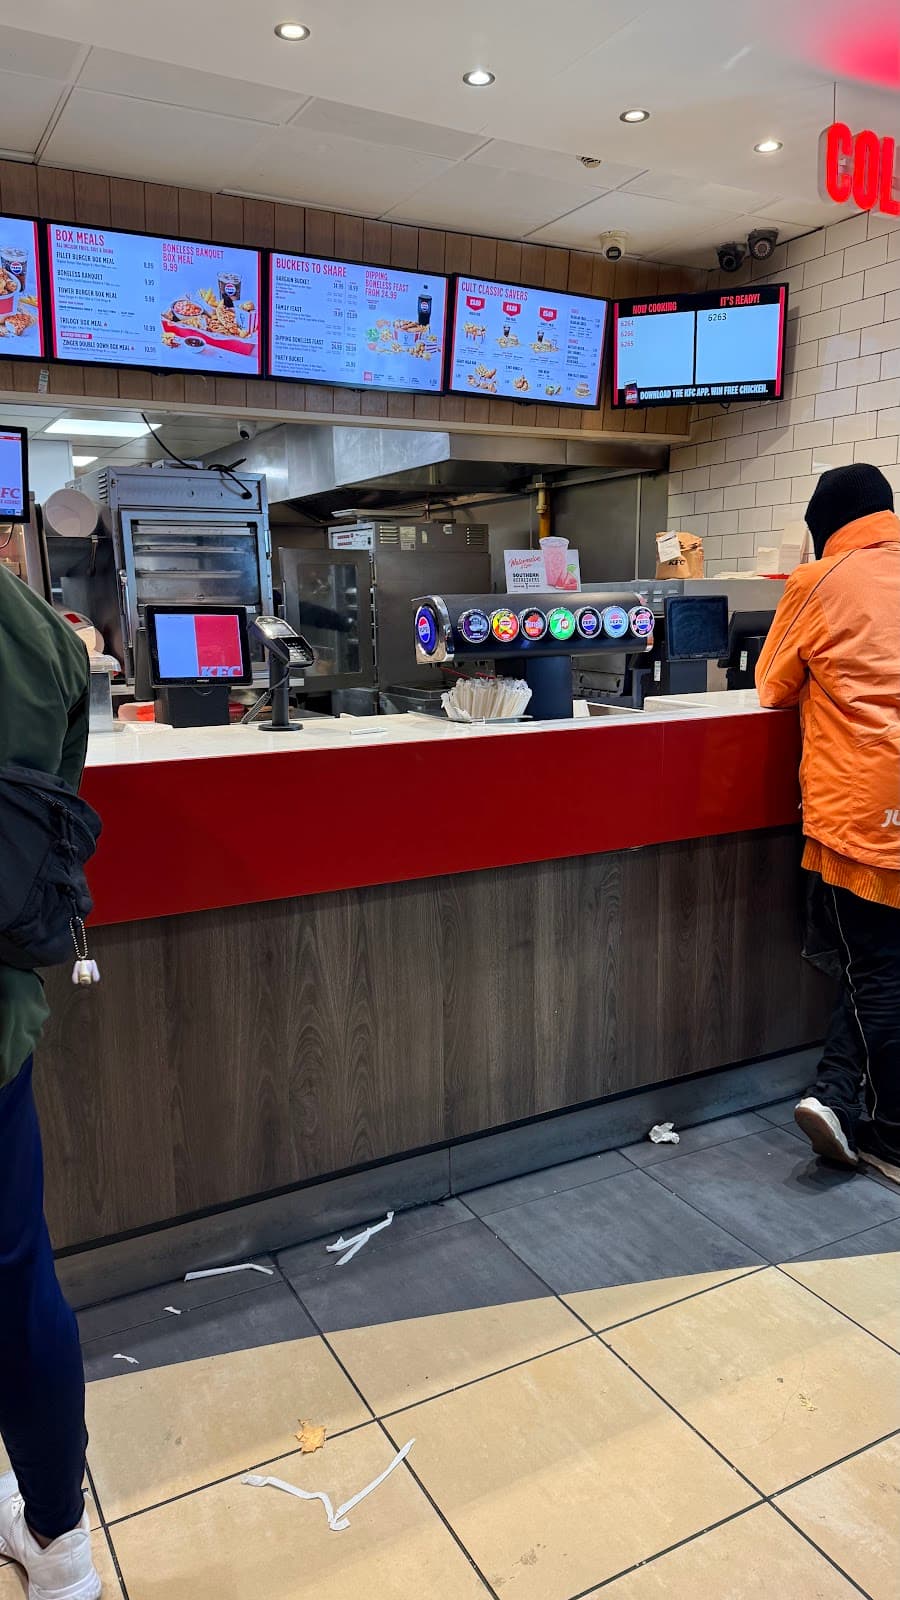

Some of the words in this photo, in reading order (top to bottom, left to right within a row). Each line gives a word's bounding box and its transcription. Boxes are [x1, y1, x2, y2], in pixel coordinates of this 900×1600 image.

[56, 229, 73, 242] BOX
[77, 232, 104, 246] MEALS
[162, 243, 194, 255] BONELESS
[195, 248, 224, 259] BANQUET
[102, 257, 115, 265] MEAL
[163, 253, 176, 262] BOX
[178, 254, 194, 264] MEAL
[163, 263, 178, 272] 9.99
[276, 258, 309, 273] BUCKETS
[312, 263, 321, 273] TO
[323, 264, 346, 277] SHARE
[365, 270, 388, 280] DIPPING
[365, 279, 392, 290] BONELESS
[393, 283, 409, 292] FEAST
[461, 281, 476, 293] CULT
[479, 284, 504, 297] CLASSIC
[505, 288, 528, 301] SAVERS
[365, 288, 380, 297] FROM
[381, 290, 398, 300] 24.99
[719, 295, 734, 306] IT'S
[735, 293, 761, 305] READY!
[633, 304, 648, 314] NOW
[649, 302, 677, 313] COOKING
[708, 312, 727, 322] 6263
[640, 389, 671, 400] DOWNLOAD
[672, 388, 683, 398] THE
[684, 388, 696, 397] KFC
[696, 387, 710, 397] APP.
[711, 386, 723, 396] WIN
[724, 385, 738, 395] FREE
[739, 384, 769, 394] CHICKEN.
[0, 487, 20, 499] FC
[201, 666, 240, 677] KFC
